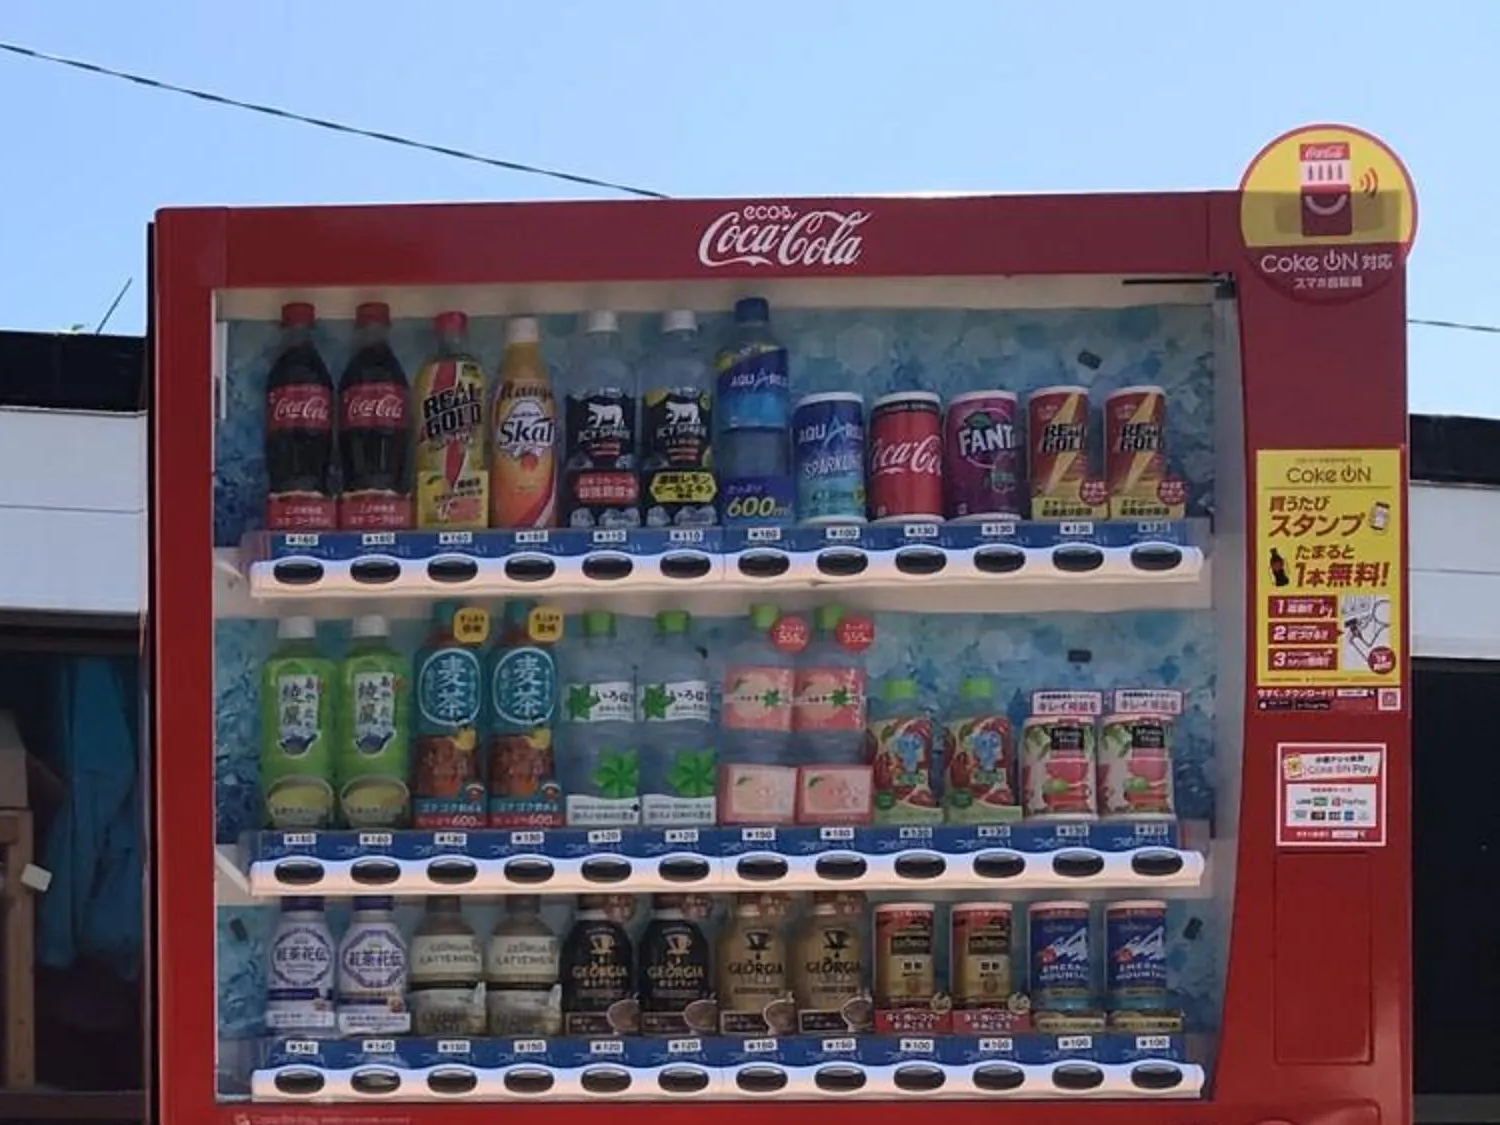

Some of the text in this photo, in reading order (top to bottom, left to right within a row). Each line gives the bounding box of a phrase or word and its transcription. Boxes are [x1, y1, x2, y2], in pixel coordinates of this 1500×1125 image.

[699, 210, 874, 267] Coca-Cola
[1261, 251, 1319, 273] Coke
[1362, 253, 1393, 270] 対応
[1286, 467, 1337, 484] Coke
[1269, 495, 1330, 513] 買うたび
[1268, 512, 1365, 538] スタンプ
[1295, 545, 1356, 560] たまると
[437, 655, 467, 718] 麦茶
[512, 654, 541, 718] 麦茶
[276, 947, 327, 962] 紅茶花伝
[349, 950, 402, 967] 紅茶花伝
